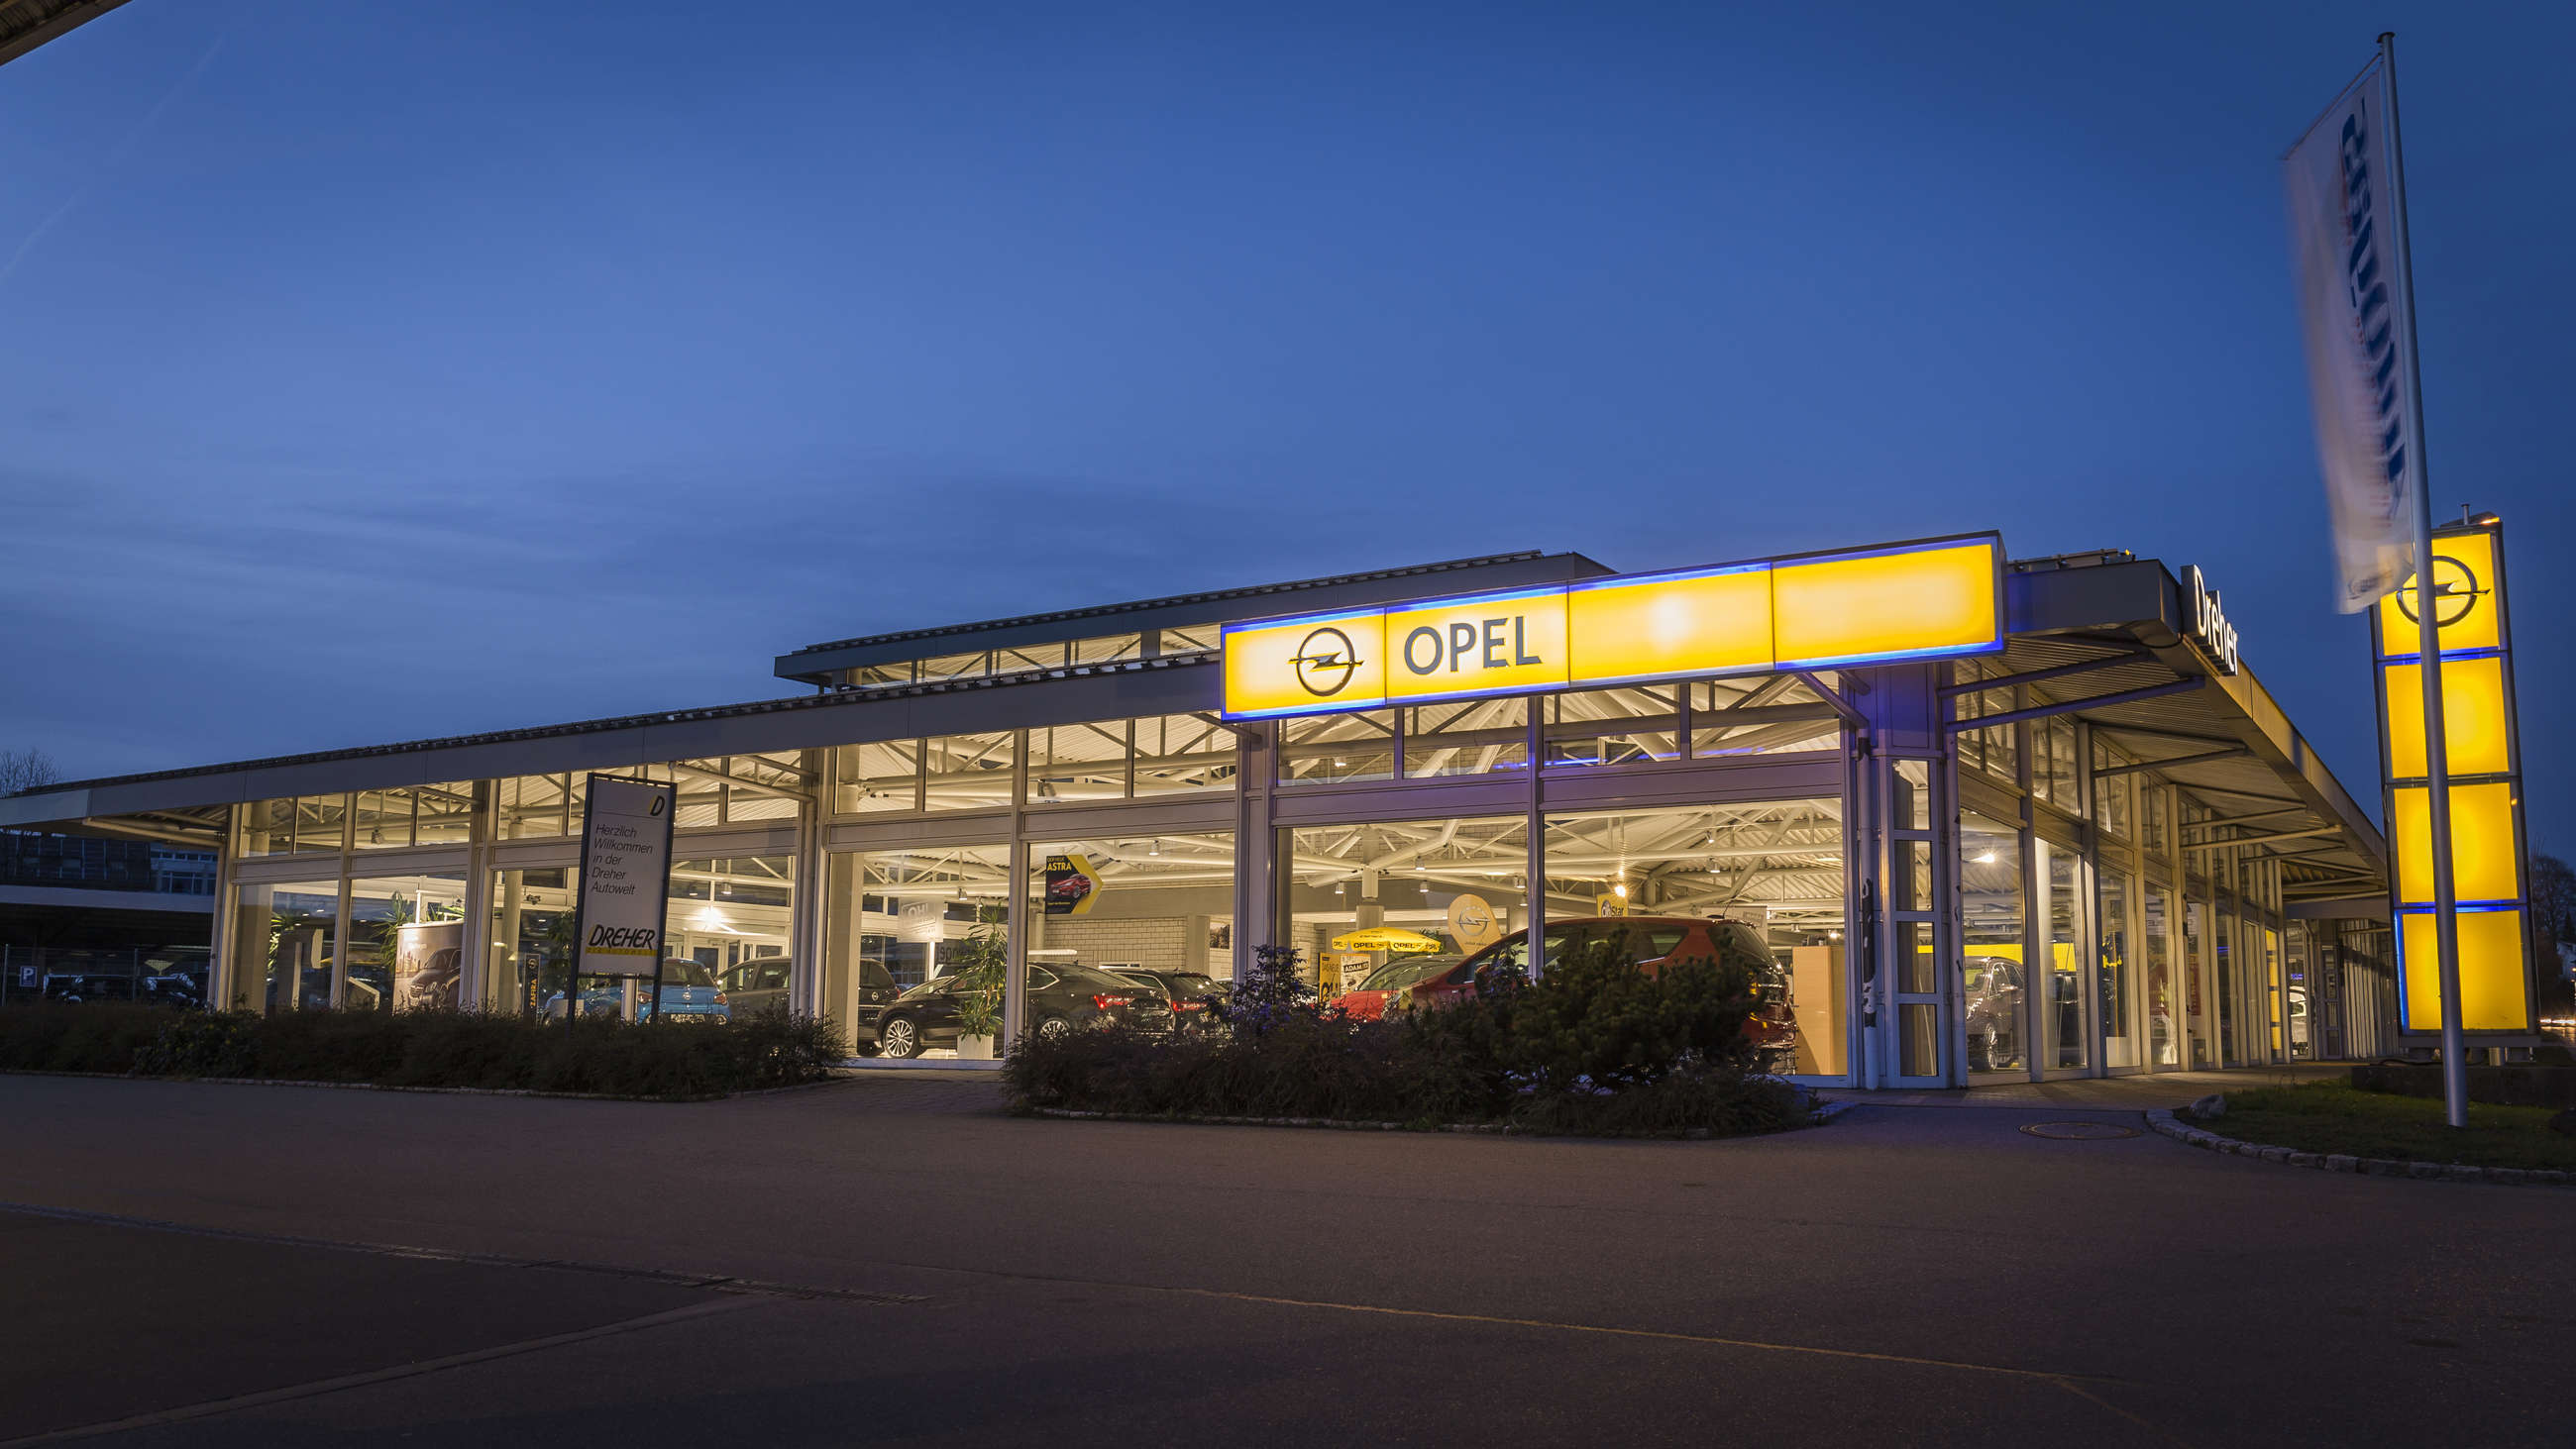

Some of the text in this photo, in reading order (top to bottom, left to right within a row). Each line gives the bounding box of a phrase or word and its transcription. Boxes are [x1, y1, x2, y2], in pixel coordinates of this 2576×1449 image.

[2194, 564, 2238, 675] Dreher
[1404, 616, 1543, 675] OPEL
[650, 795, 665, 816] D
[595, 824, 637, 839] Herzlich
[594, 838, 653, 854] Willkommen
[592, 853, 623, 865] in der
[591, 867, 626, 880] Dreher
[1047, 862, 1071, 872] ASTRA
[591, 881, 636, 895] Autowelt
[588, 924, 655, 950] DREHER
[23, 968, 34, 980] P
